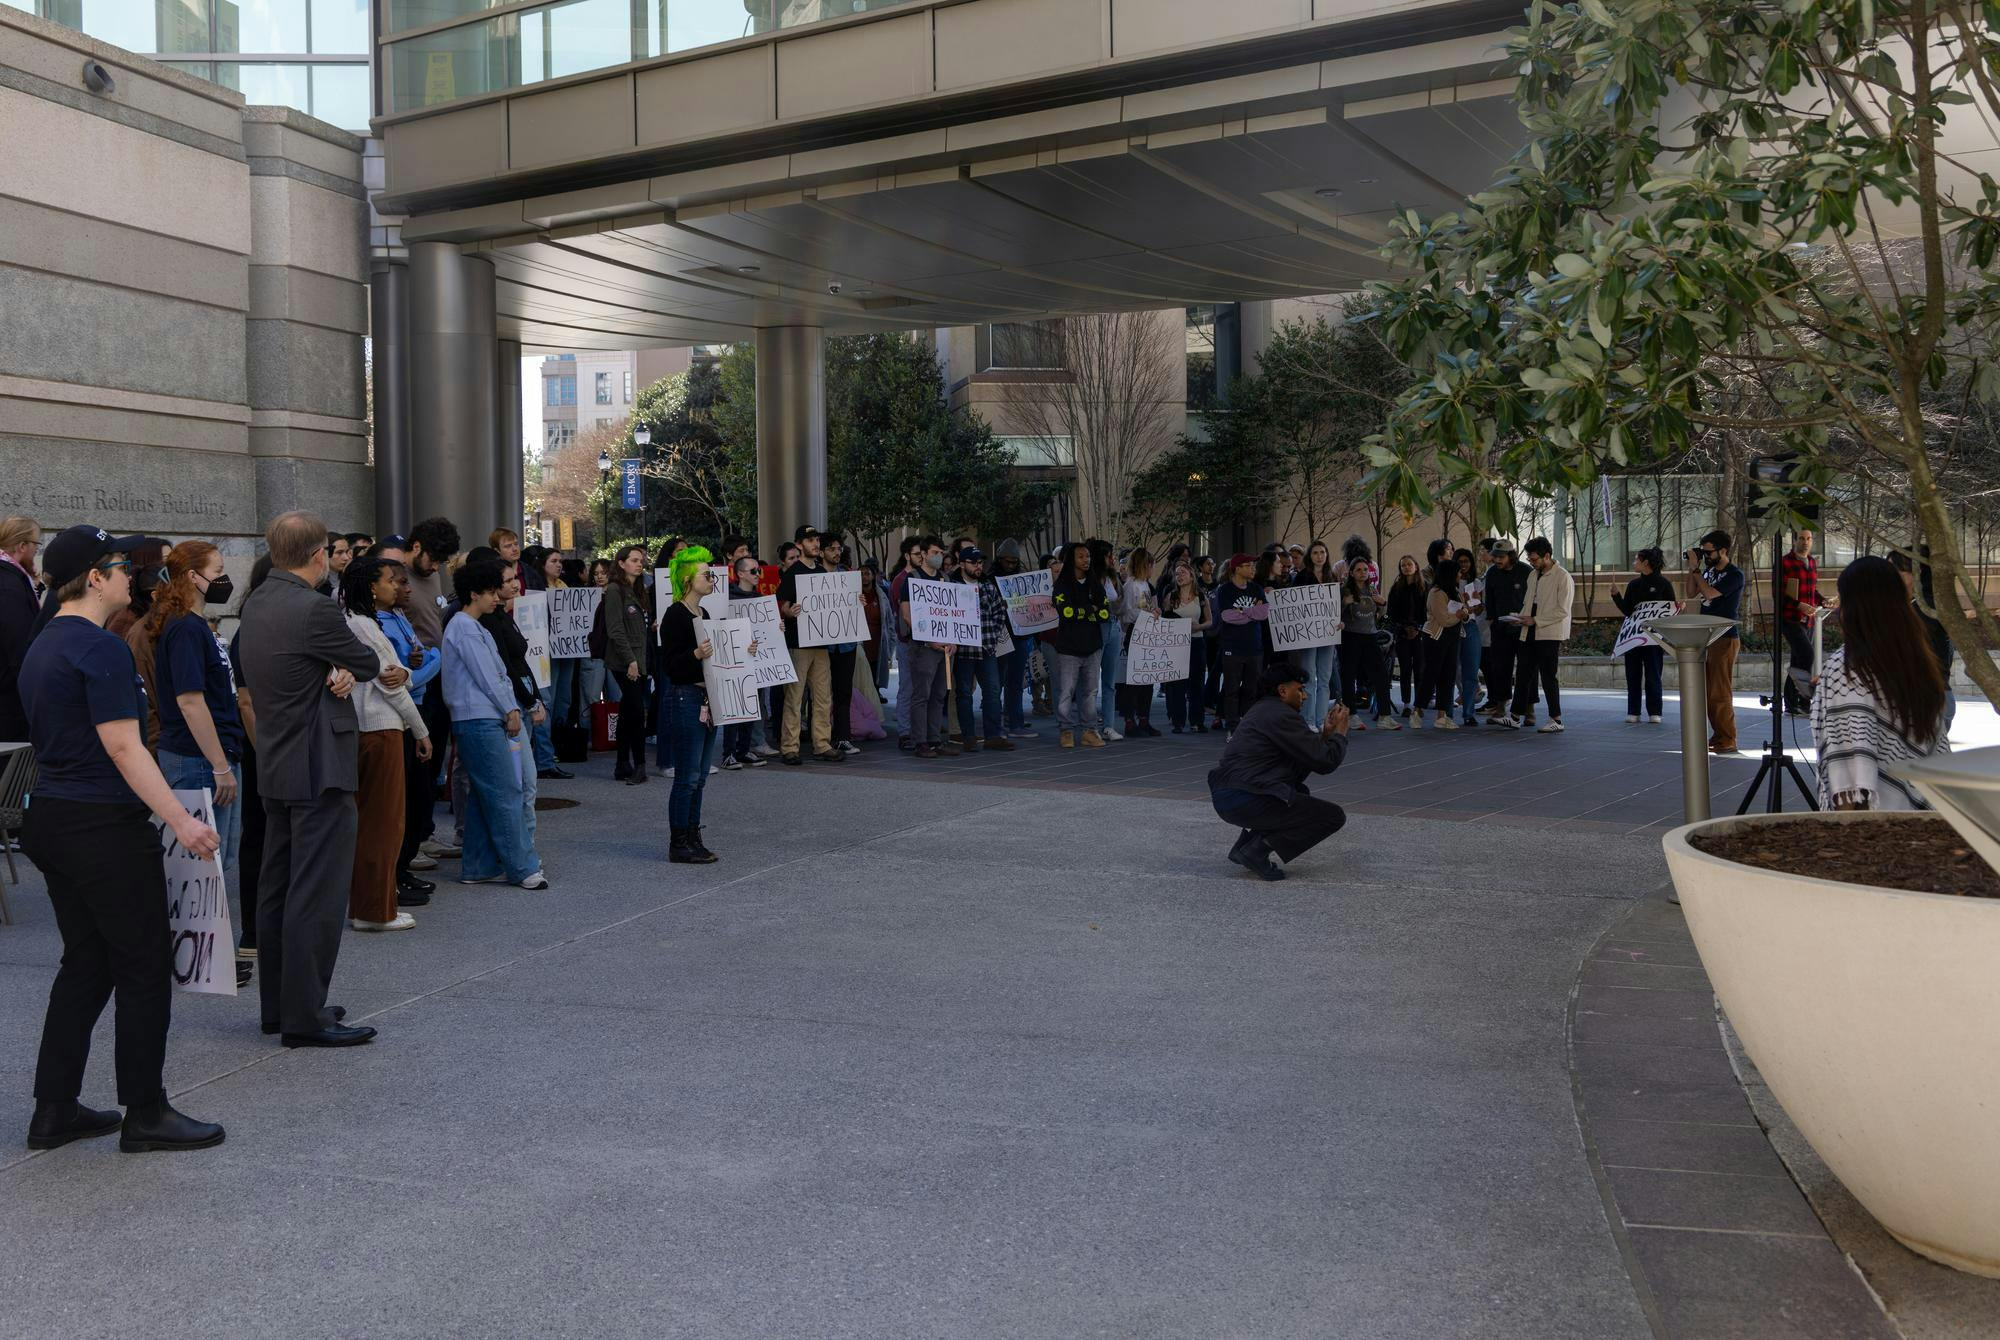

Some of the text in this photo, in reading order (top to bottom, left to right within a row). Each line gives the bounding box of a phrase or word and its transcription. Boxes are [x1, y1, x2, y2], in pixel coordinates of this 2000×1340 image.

[626, 462, 637, 495] EMORY
[32, 486, 87, 510] Crum
[94, 488, 154, 513] Rollins
[161, 493, 228, 517] Building
[809, 574, 848, 592] FAIR
[553, 588, 597, 613] EMORY
[801, 591, 860, 613] CONTRACT
[911, 583, 958, 608] PASSION
[1273, 582, 1337, 606] PROTECT
[929, 606, 966, 619] DOES NOT
[1633, 602, 1671, 612] ANT A
[569, 615, 590, 631] ARE
[807, 607, 859, 640] NOW
[930, 619, 980, 643] PAY RENT
[1144, 616, 1176, 634] FREE
[1274, 618, 1336, 645] WORKERS
[549, 635, 590, 656] WORKE
[1131, 629, 1191, 646] EXPRESSION
[528, 645, 544, 657] AIR
[754, 647, 777, 662] NT
[1140, 647, 1156, 661] IS
[1160, 649, 1169, 660] A
[754, 663, 794, 684] INNER
[1133, 660, 1174, 672] LABOR
[1132, 670, 1182, 684] CONCERN
